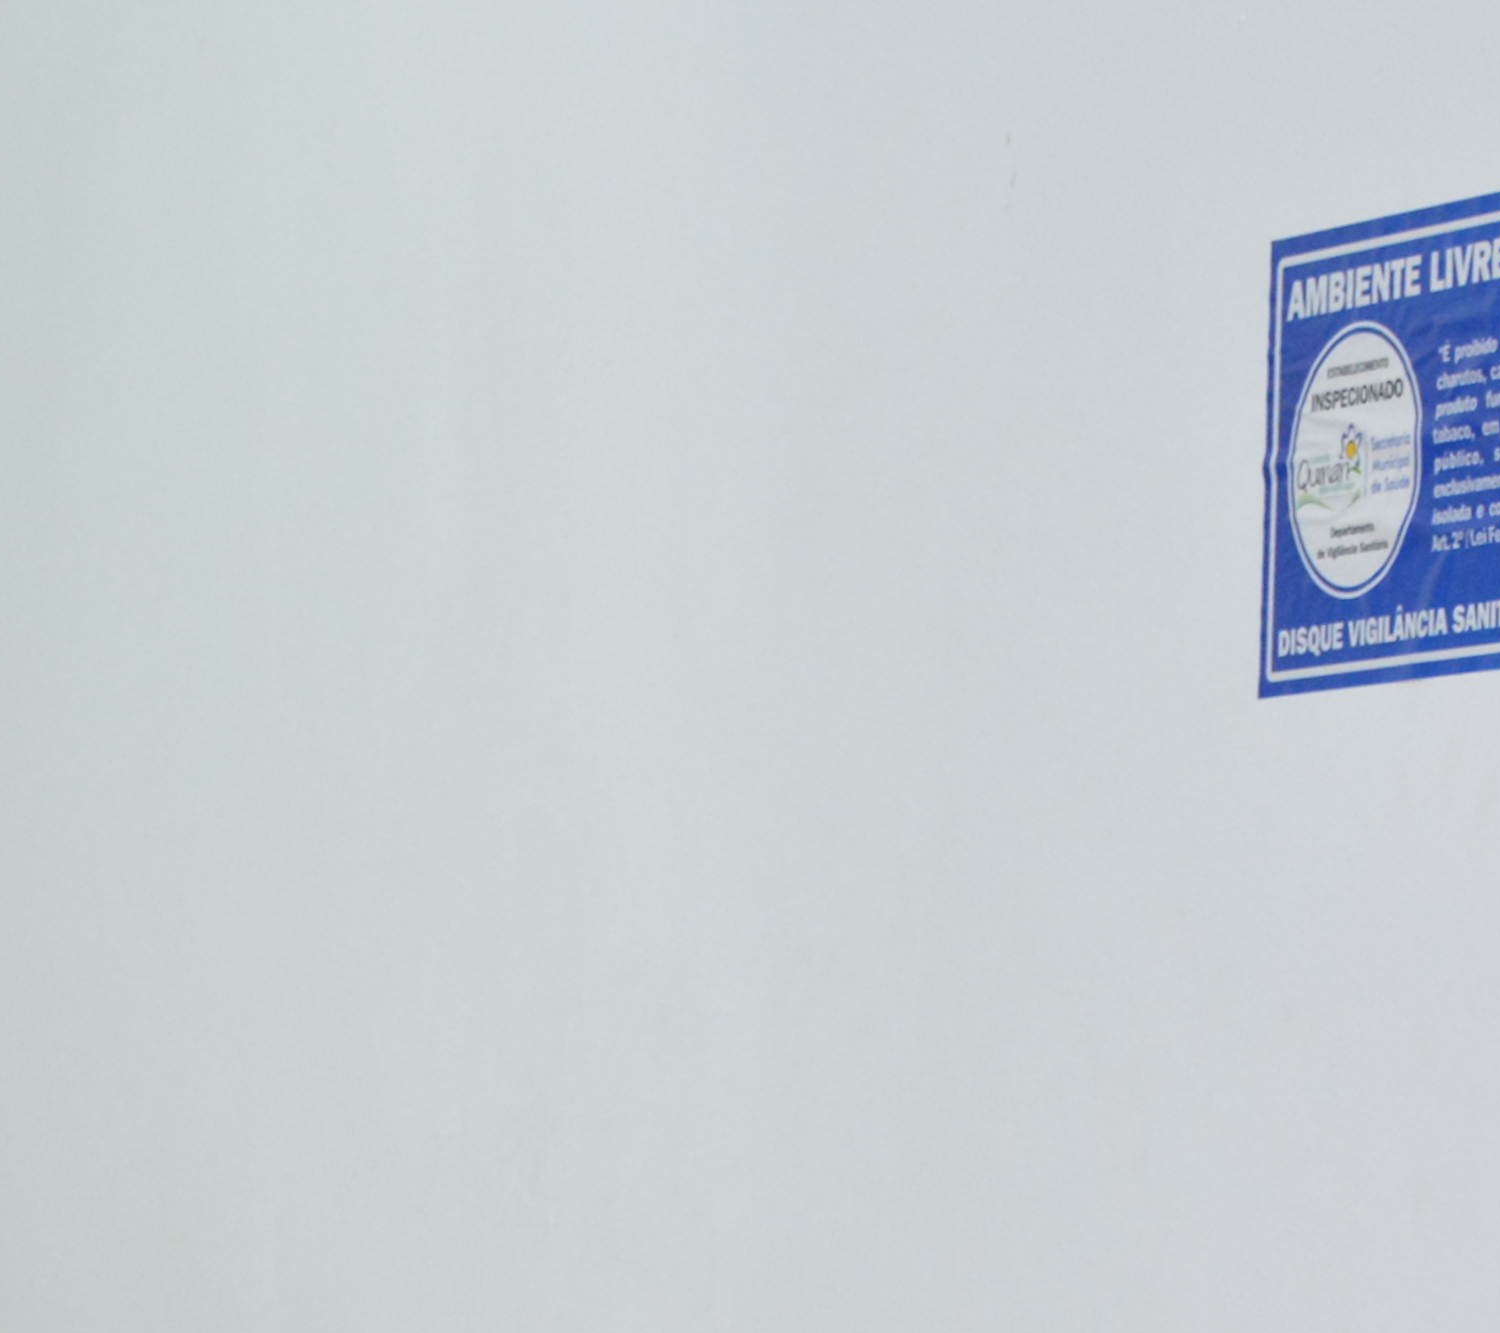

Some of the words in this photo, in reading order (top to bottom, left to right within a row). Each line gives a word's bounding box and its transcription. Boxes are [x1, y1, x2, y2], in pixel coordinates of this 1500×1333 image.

[1287, 254, 1422, 321] AMBIENTE
[1454, 338, 1498, 364] proibido
[1311, 378, 1404, 413] INSPECIONADO
[1435, 396, 1477, 420] produto
[1433, 424, 1475, 444] tabaco,
[1482, 420, 1500, 436] em
[1434, 450, 1483, 474] público,
[1432, 504, 1472, 525] isolada
[1476, 504, 1484, 518] e
[1432, 534, 1450, 552] Art.
[1278, 621, 1343, 658] DISQUE
[1347, 606, 1447, 649] VIGILÂNCIA
